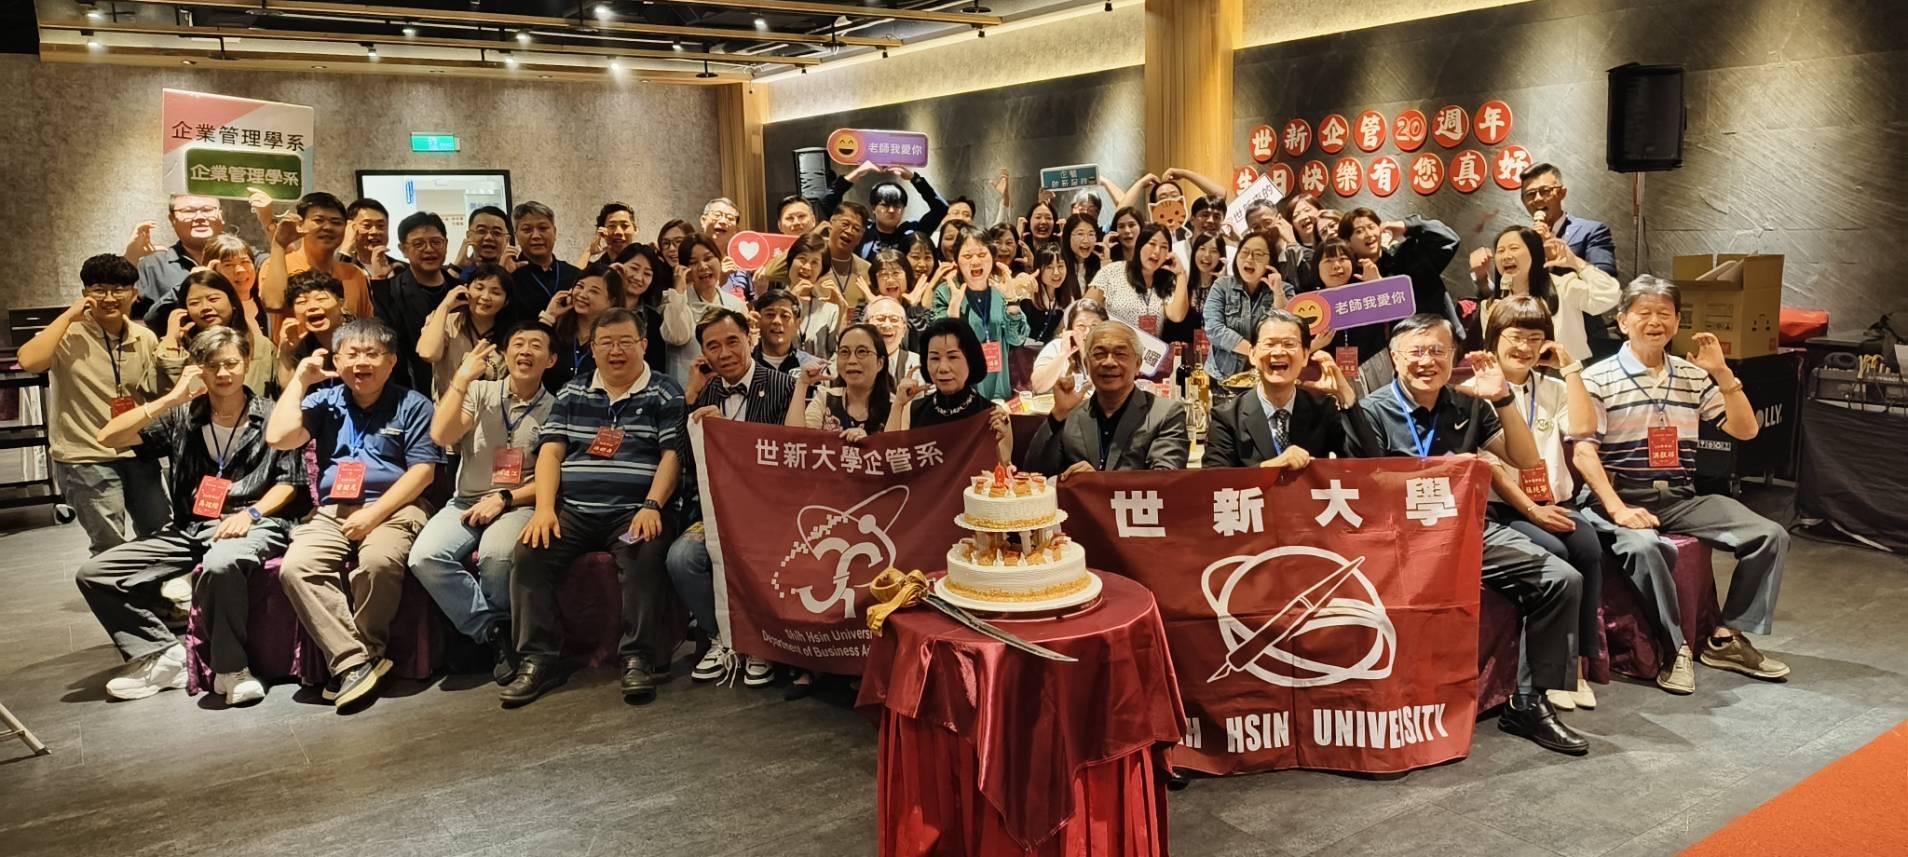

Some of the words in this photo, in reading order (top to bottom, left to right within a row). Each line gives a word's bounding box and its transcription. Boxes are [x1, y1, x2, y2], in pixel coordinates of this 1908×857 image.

[172, 120, 305, 152] 企業管理學系
[1252, 106, 1505, 157] 世新企管20週年
[868, 142, 922, 156] 老師我愛你
[190, 163, 299, 186] 企業管理學系
[1335, 290, 1406, 315] 老師我愛你
[755, 438, 944, 476] 世新大學企管系
[1110, 477, 1459, 538] 世新大學
[805, 630, 831, 643] Hsin
[803, 645, 813, 657] of
[812, 645, 860, 658] Business
[1225, 711, 1290, 753] HSIN
[1312, 703, 1449, 750] UNIVESITY
